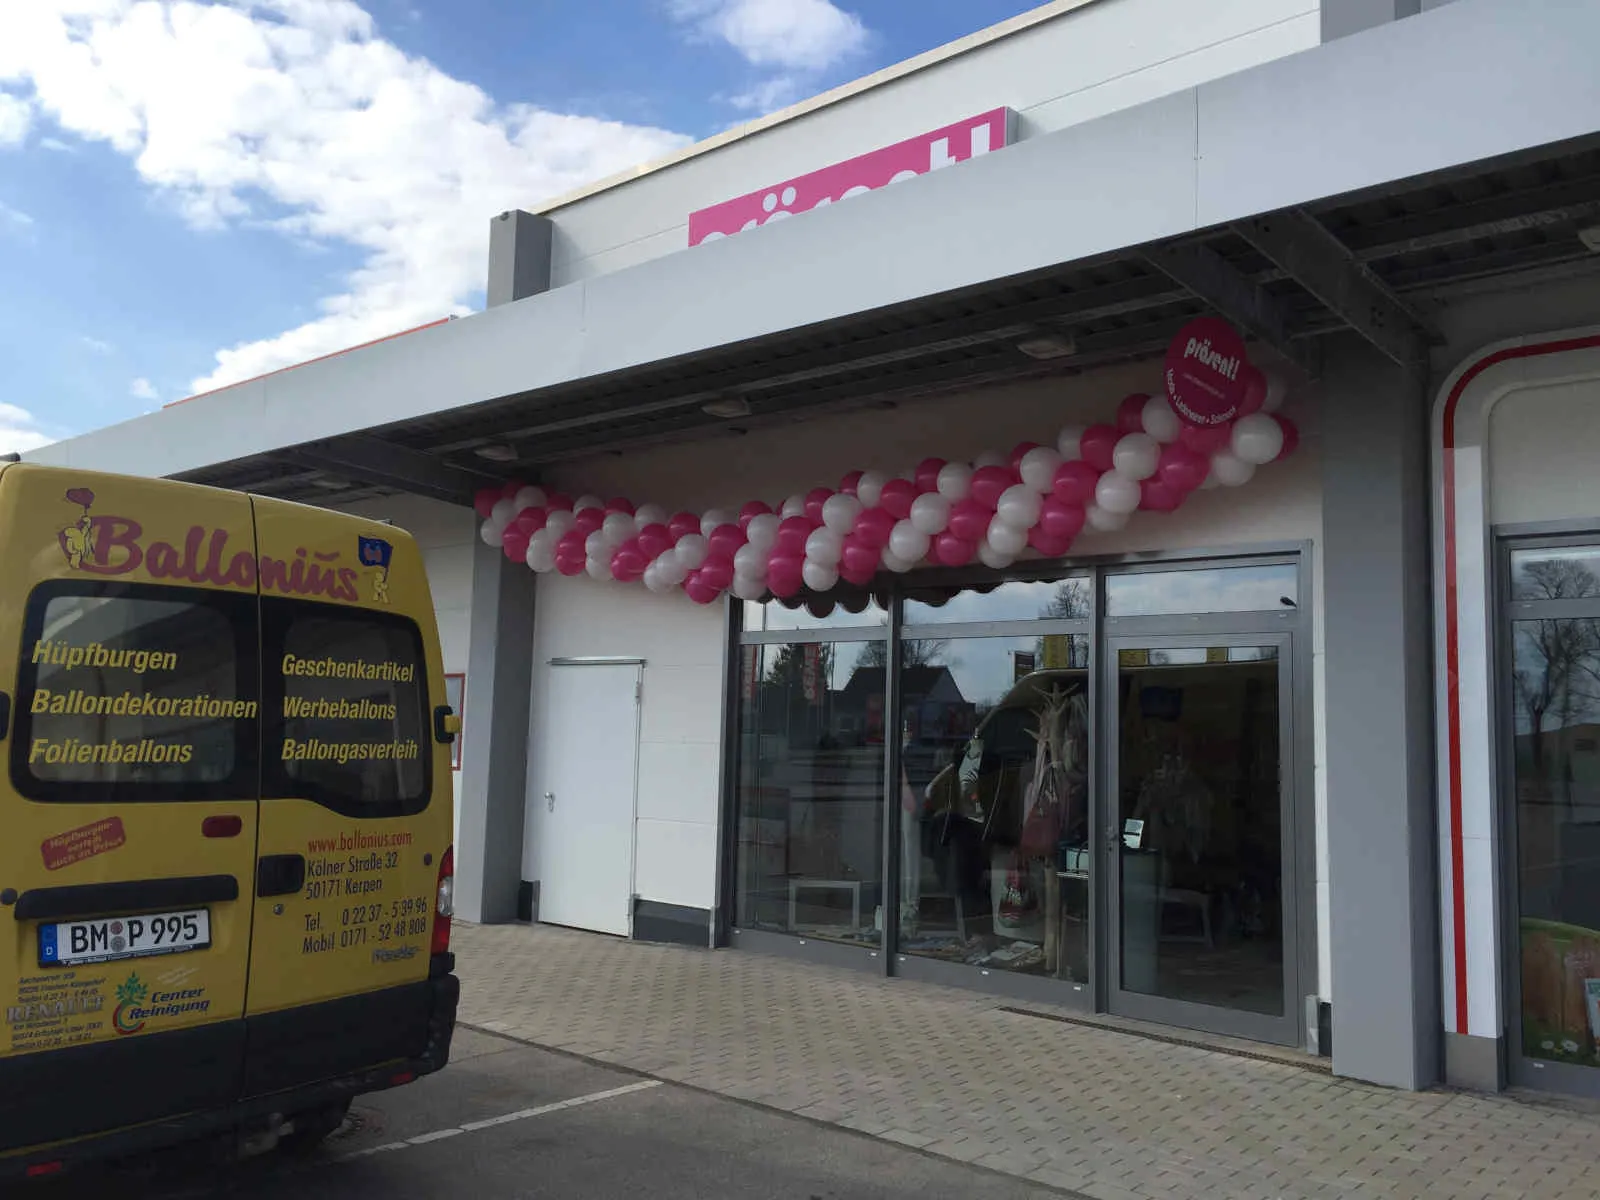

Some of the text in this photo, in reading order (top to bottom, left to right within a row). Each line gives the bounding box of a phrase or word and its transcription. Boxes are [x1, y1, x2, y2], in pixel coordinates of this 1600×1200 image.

[31, 640, 178, 674] Hüpfburgen
[282, 654, 414, 682] Geschenkartikel
[30, 689, 257, 718] Ballondekorationen
[282, 696, 397, 721] Werbeballons
[28, 738, 193, 764] Folienballons
[281, 738, 418, 764] Ballongasverleih
[308, 852, 398, 877] Kölner Straße 32
[306, 879, 382, 899] 50171 Kerpen
[71, 914, 198, 953] BM P 995
[305, 912, 322, 931] Tel.
[303, 932, 335, 953] Mobil
[341, 928, 366, 947] 0171
[151, 985, 206, 1003] Center
[128, 999, 210, 1021] Reinigung
